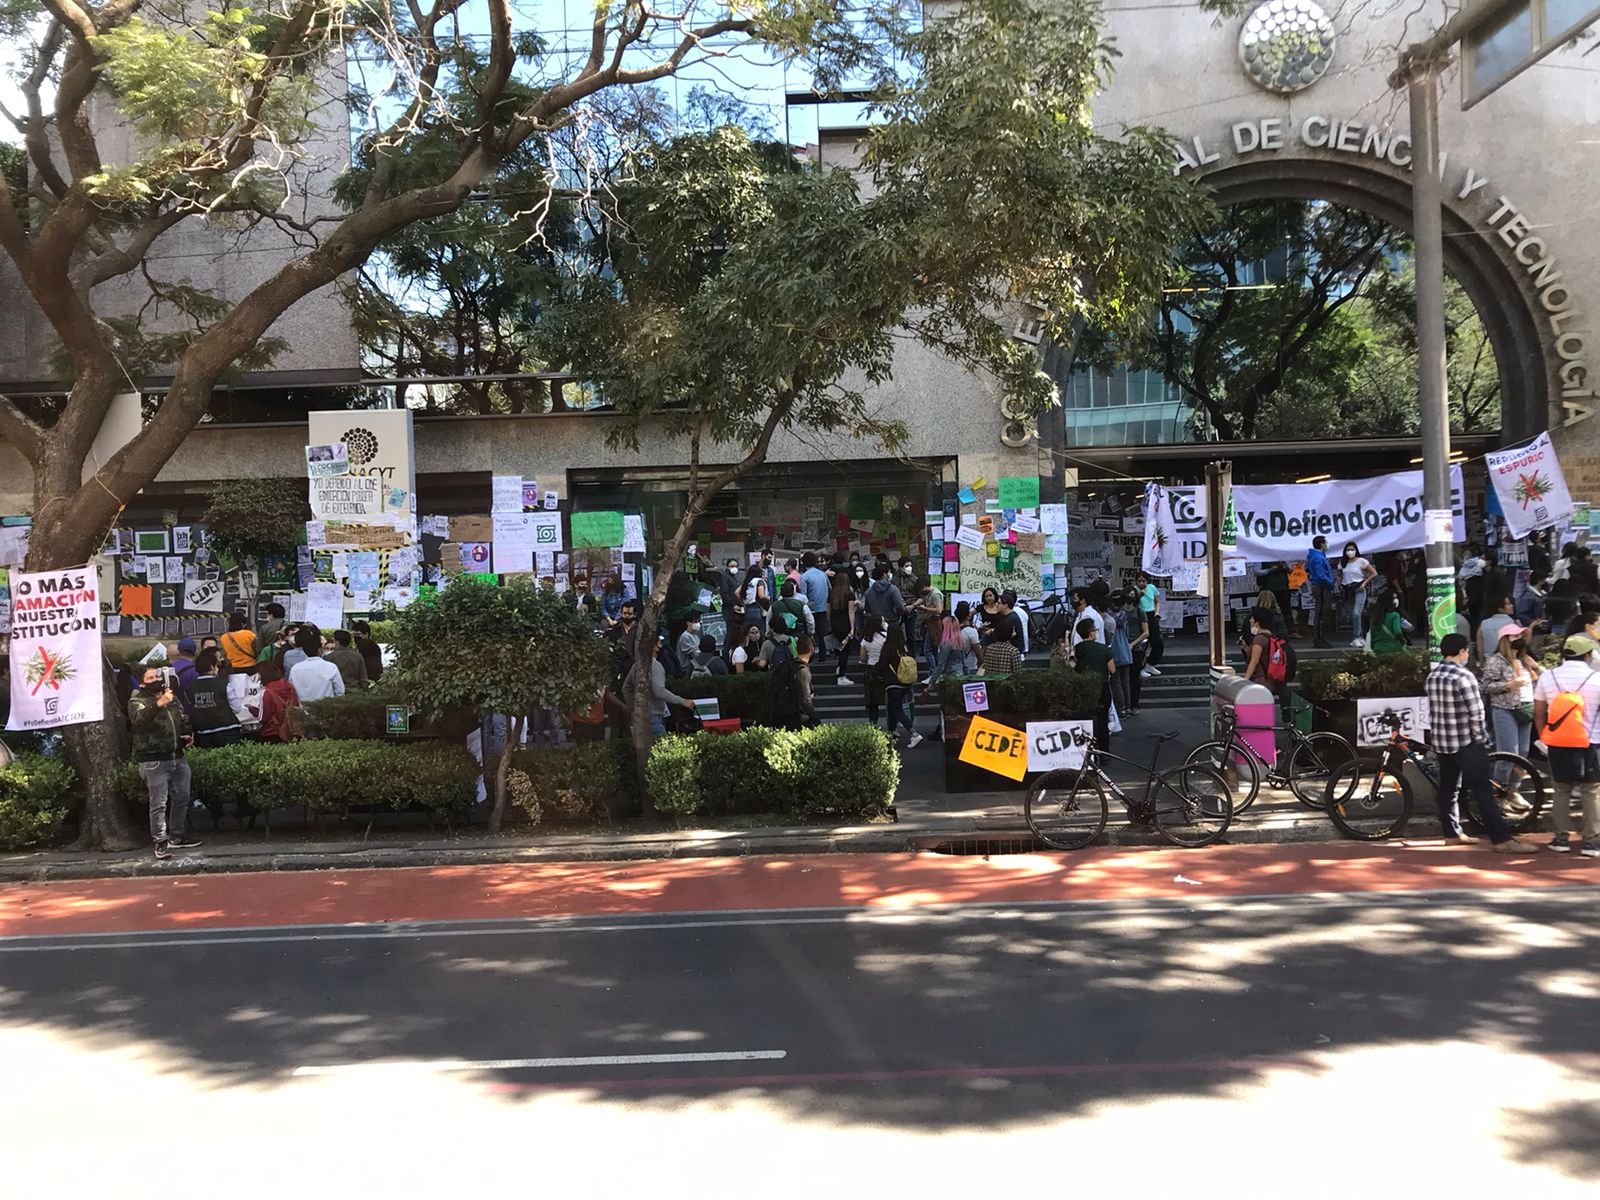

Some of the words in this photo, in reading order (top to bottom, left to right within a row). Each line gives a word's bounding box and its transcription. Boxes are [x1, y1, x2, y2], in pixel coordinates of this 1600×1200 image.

[1232, 118, 1284, 153] DE
[1457, 168, 1489, 201] Y
[1485, 194, 1596, 428] TECNOLOGÍA
[1498, 451, 1545, 475] ESPURIO
[38, 574, 86, 594] MÁS
[189, 582, 219, 605] CIDE
[15, 590, 96, 611] AMACIÓN
[18, 608, 78, 623] NUESTR
[974, 730, 1022, 758] CIDE
[1035, 726, 1086, 756] CIDE
